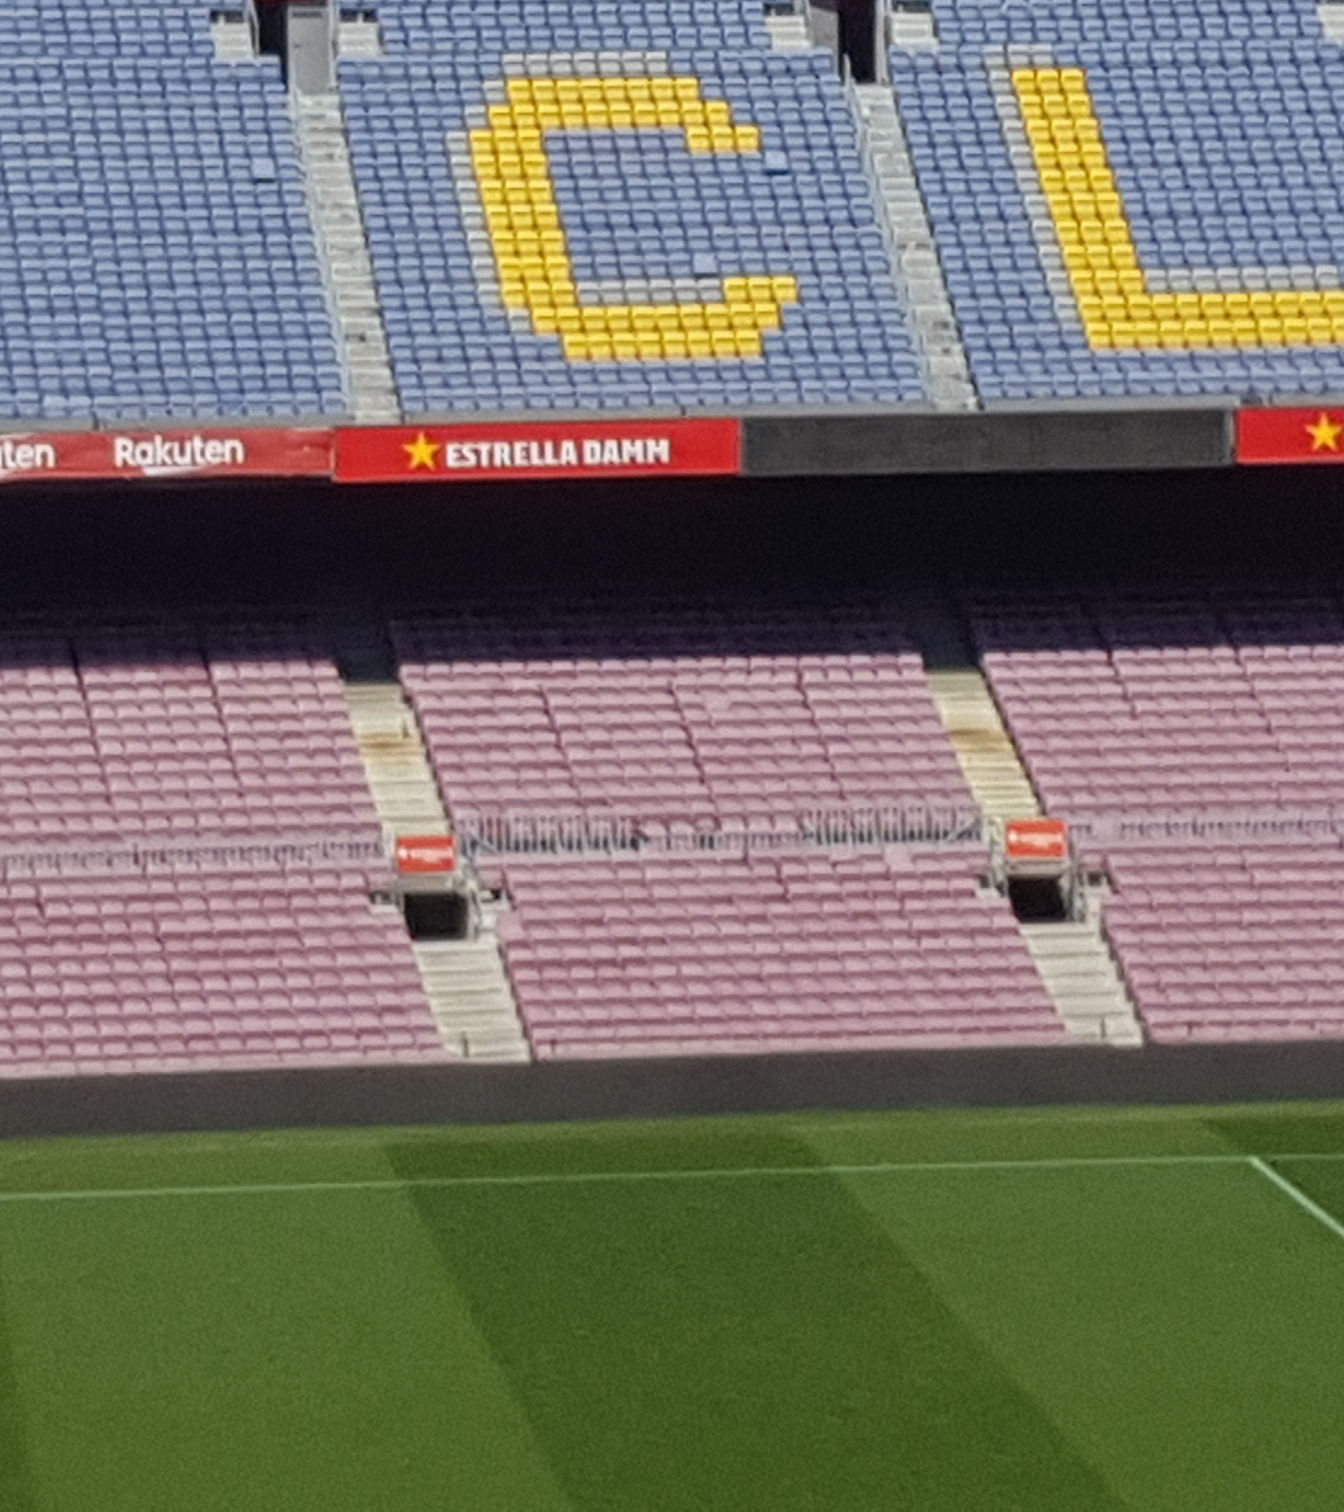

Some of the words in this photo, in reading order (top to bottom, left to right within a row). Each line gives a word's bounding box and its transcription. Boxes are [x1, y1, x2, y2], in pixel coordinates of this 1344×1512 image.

[115, 435, 243, 469] Rakuten
[446, 440, 577, 467] ESTRELLA
[582, 438, 669, 465] DAMM
